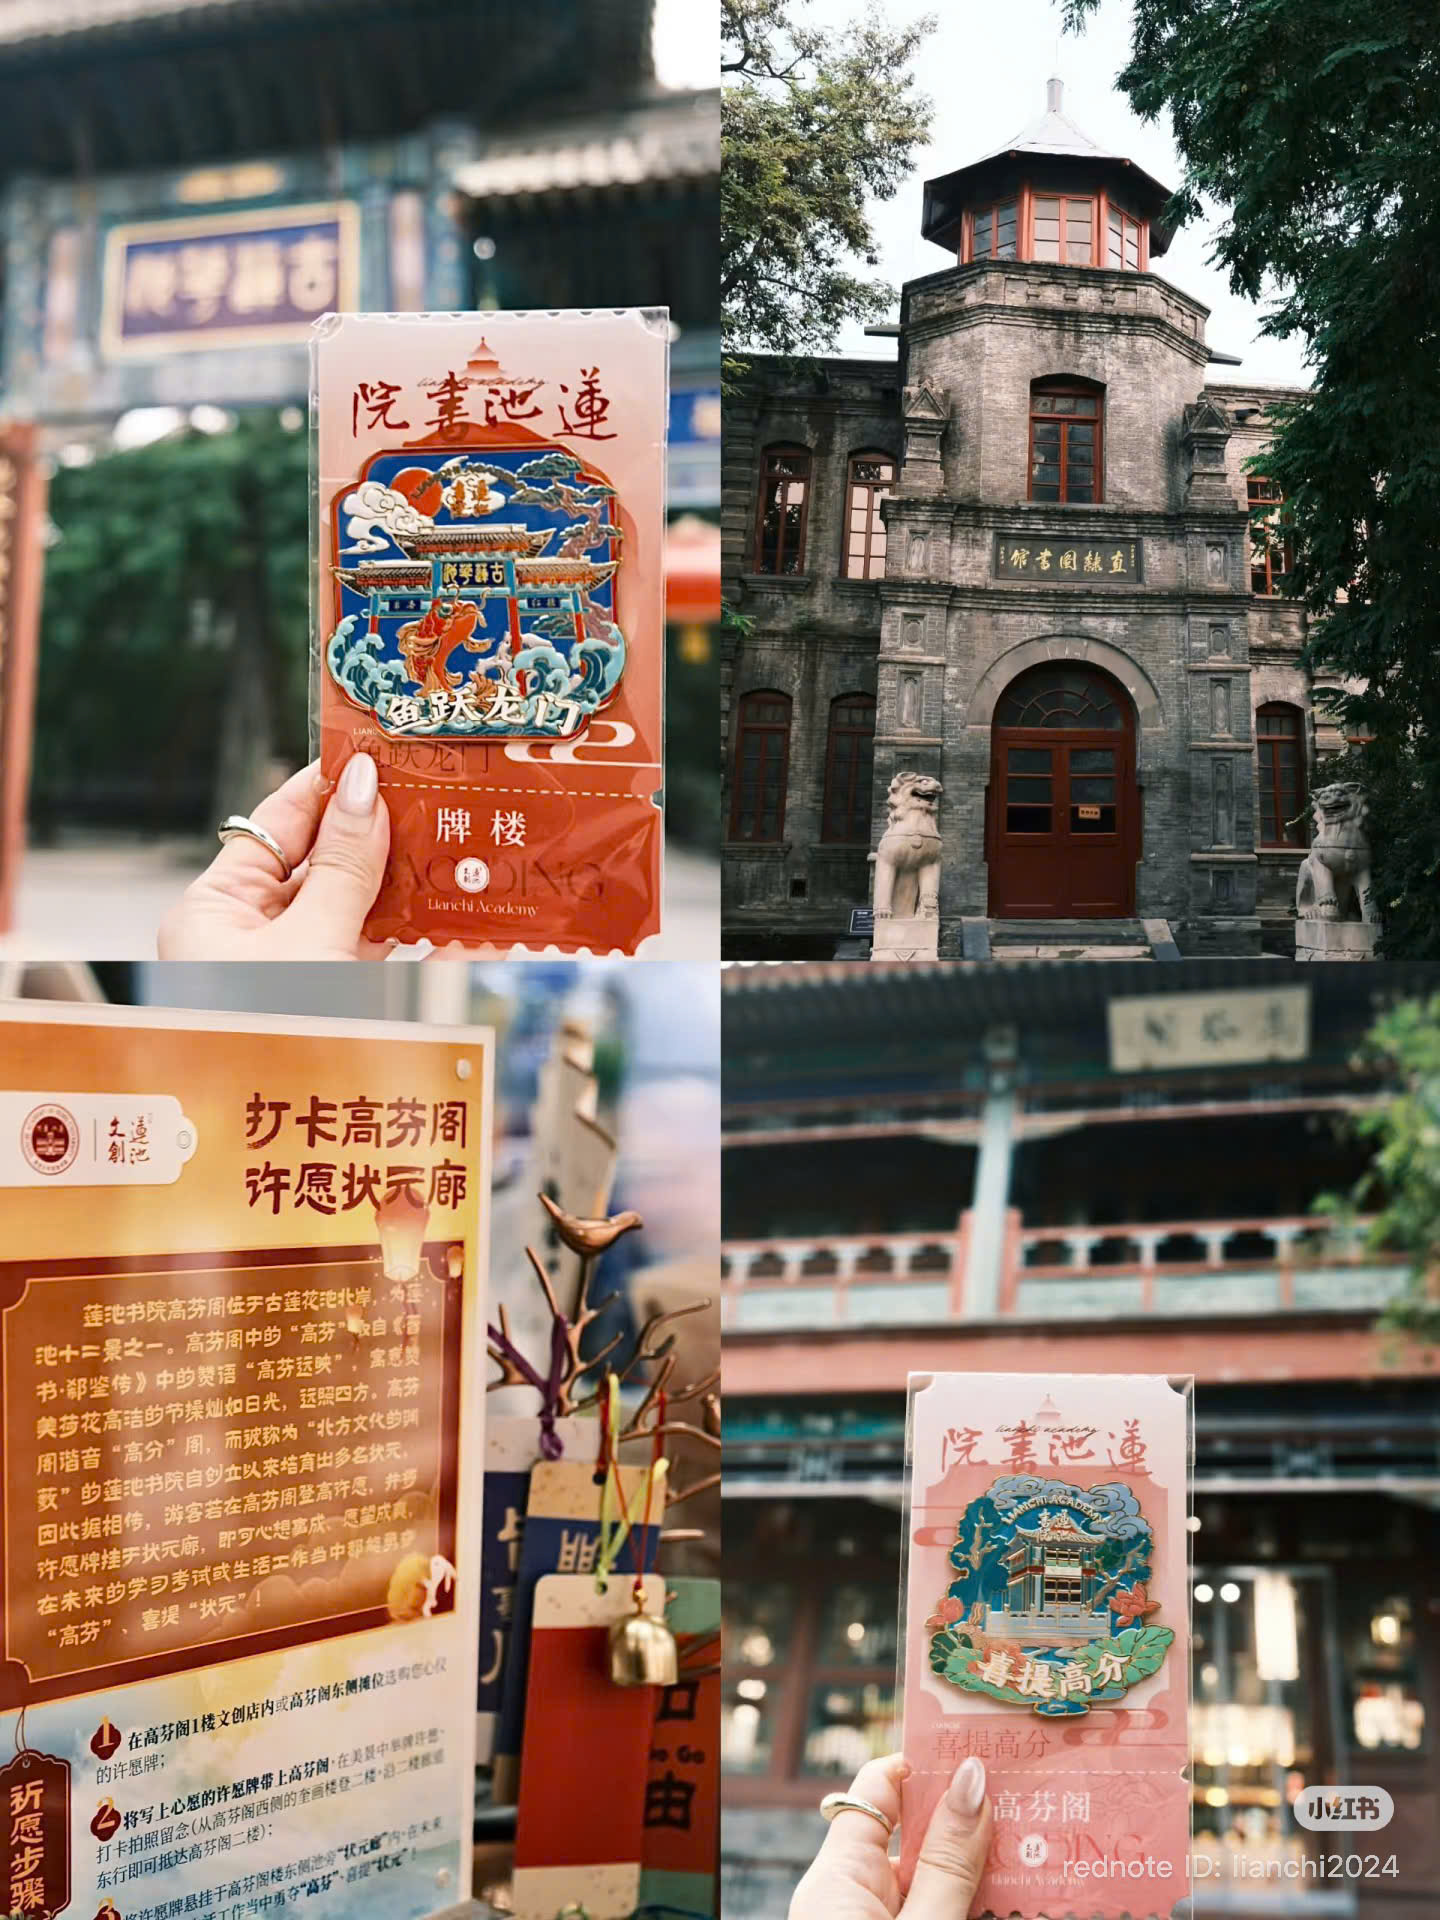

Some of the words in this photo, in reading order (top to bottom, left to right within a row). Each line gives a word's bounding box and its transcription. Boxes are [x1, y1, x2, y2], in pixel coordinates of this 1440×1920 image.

[386, 685, 581, 736] 鱼跃龙门
[353, 727, 377, 736] LIAN
[436, 807, 528, 848] 牌楼
[427, 897, 474, 913] Lianchi
[476, 899, 540, 917] Academy
[245, 1092, 468, 1151] 打卡高芬阁
[245, 1158, 468, 1216] 许愿状元廊
[977, 1651, 1132, 1698] 喜提高分
[97, 1715, 115, 1749] 1
[933, 1728, 1051, 1760] 喜提高分
[96, 1796, 116, 1830] 2
[992, 1790, 1091, 1823] 高芬阁
[10, 1779, 45, 1911] 祈愿步骤
